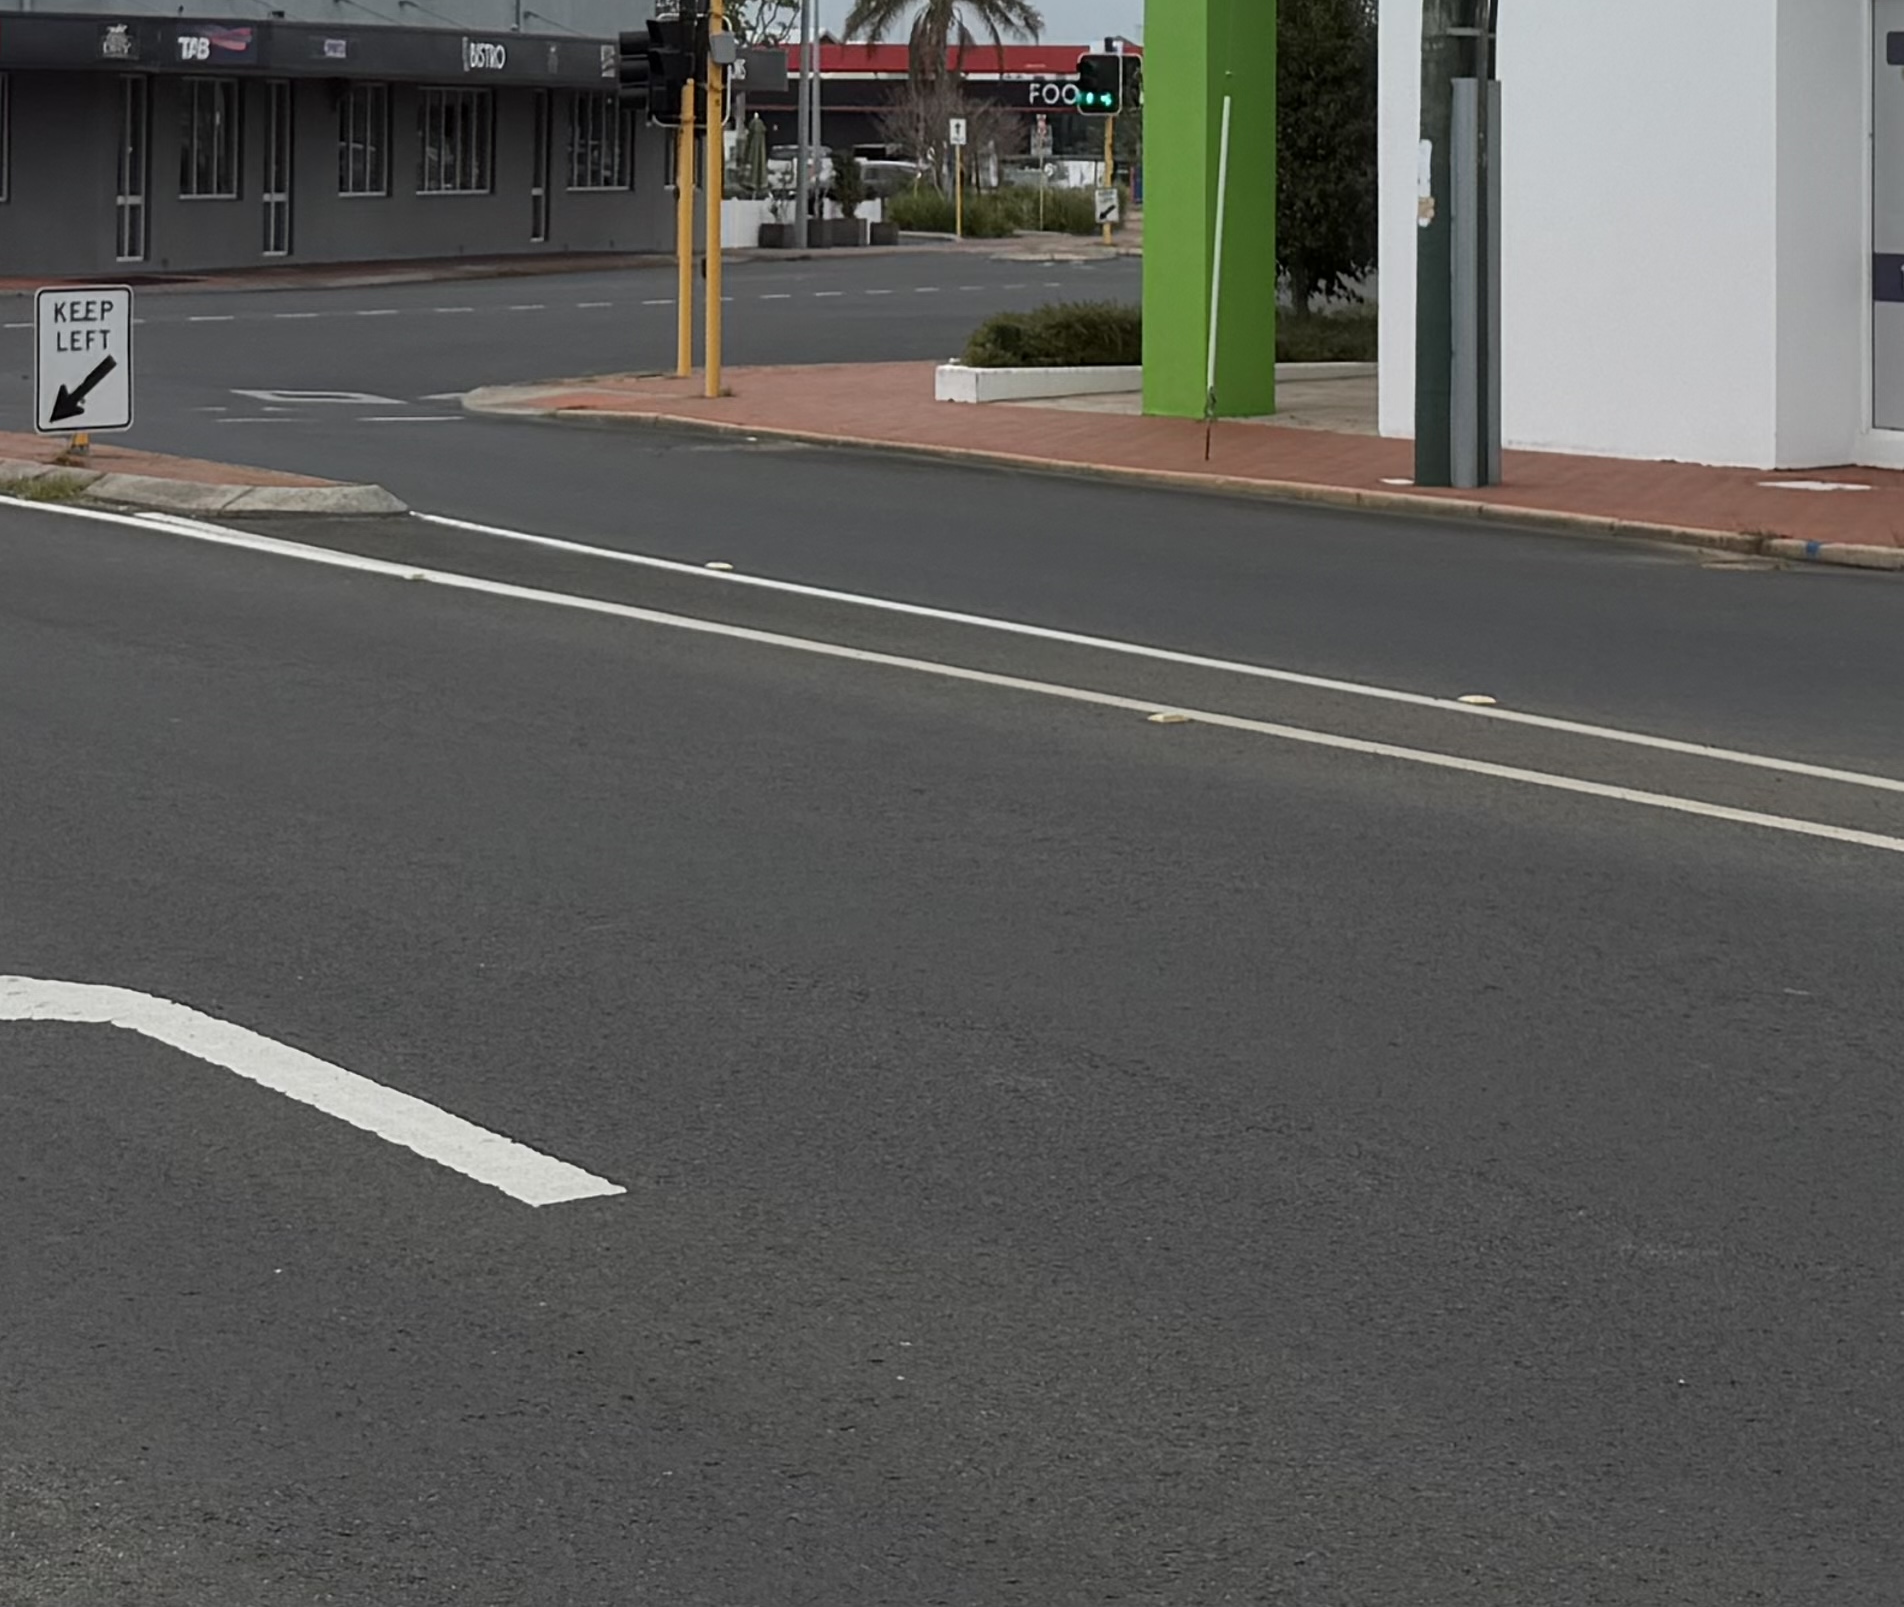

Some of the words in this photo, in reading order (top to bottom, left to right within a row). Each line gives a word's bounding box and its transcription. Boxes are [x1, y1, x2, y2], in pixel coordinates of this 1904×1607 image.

[177, 36, 211, 60] TAB
[53, 300, 114, 323] KEEP
[56, 329, 111, 352] LEFT
